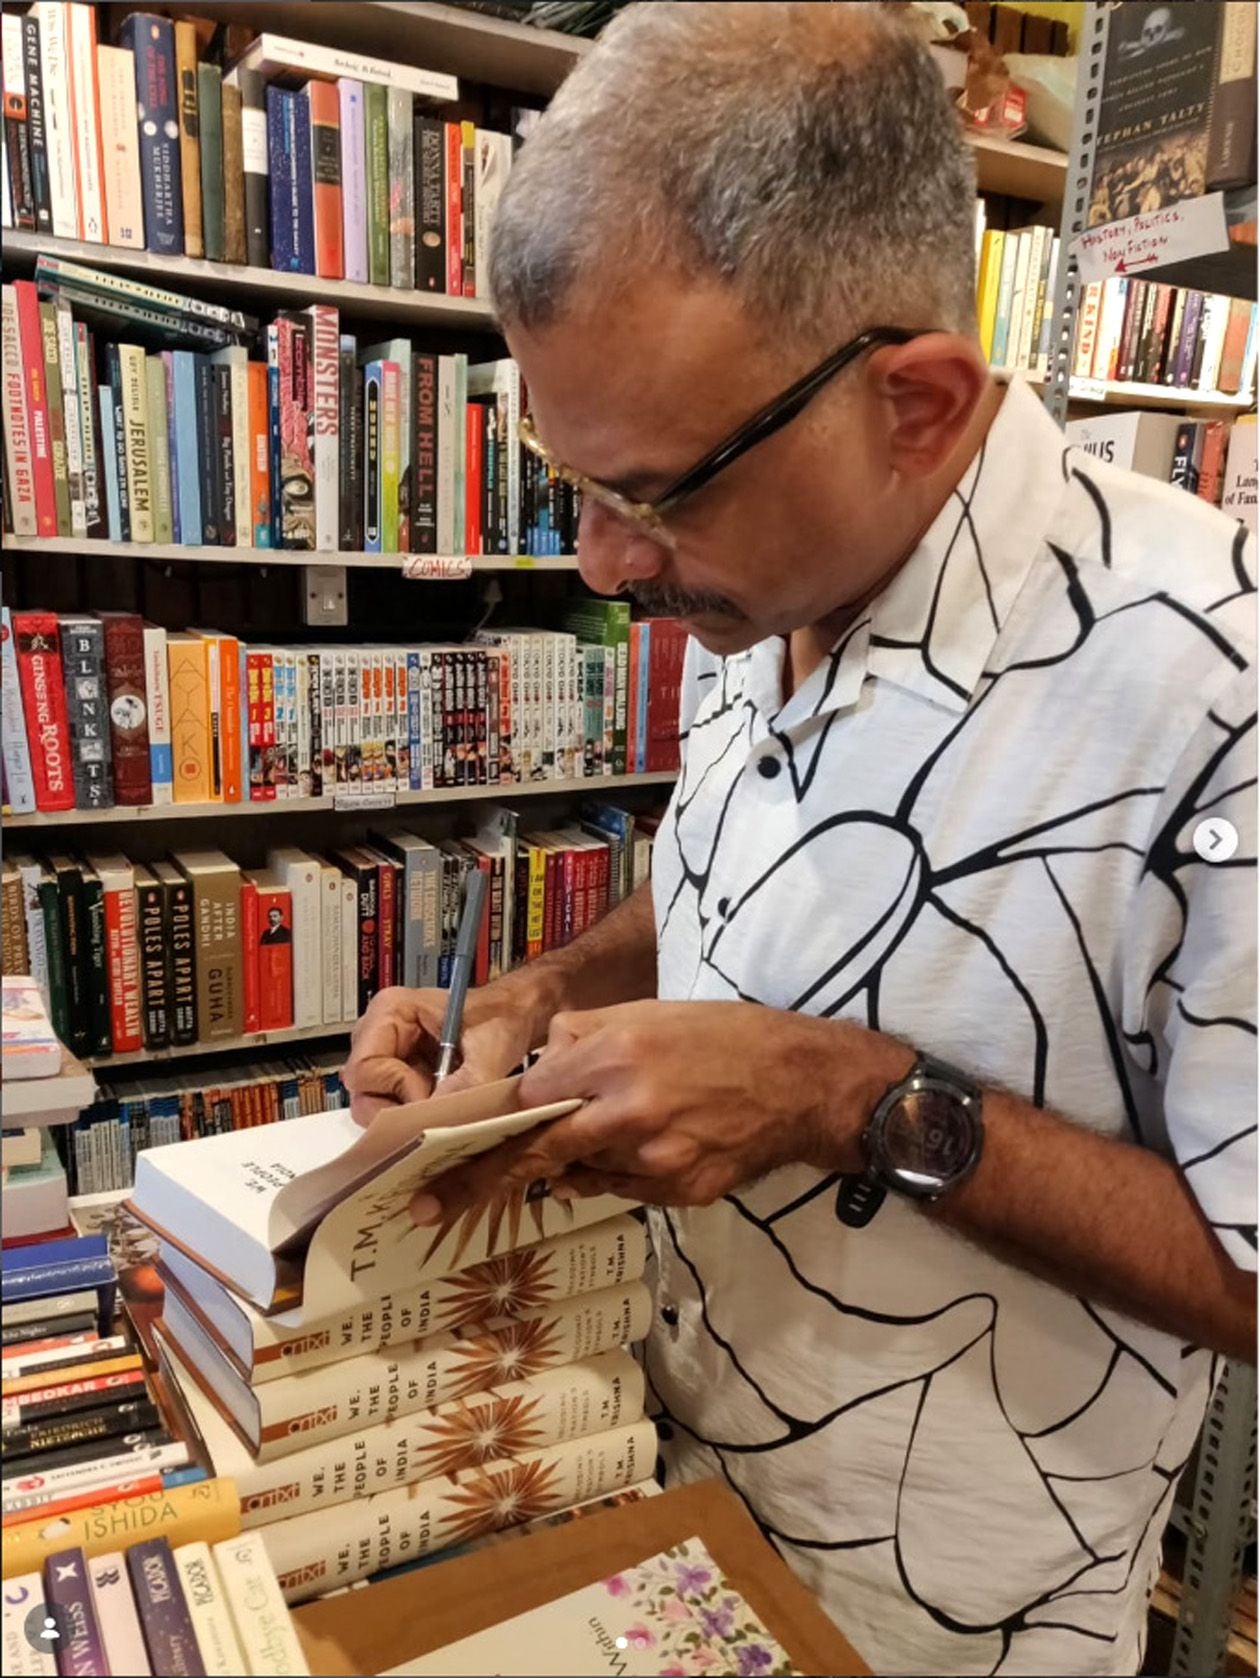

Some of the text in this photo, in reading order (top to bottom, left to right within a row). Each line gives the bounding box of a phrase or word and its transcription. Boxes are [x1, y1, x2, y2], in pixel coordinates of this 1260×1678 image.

[26, 23, 44, 148] GENE MACHINE
[1096, 102, 1206, 146] TEPHAN TALTY
[430, 130, 441, 180] DONNA
[152, 145, 164, 220] MUKHERJEE
[161, 142, 174, 226] SIDDHARTHA
[315, 305, 339, 436] MONSTERS
[418, 358, 434, 426] FROM
[7, 373, 26, 446] FOOTNOTES
[33, 410, 47, 458] PALESTINE
[15, 450, 27, 463] IN
[130, 419, 150, 512] JERUSALEM
[418, 432, 434, 498] HELL
[16, 468, 32, 502] GAZA
[407, 557, 467, 579] COMICS
[31, 655, 64, 792] GINSENG ROOTS
[153, 693, 164, 734] TSUGE
[200, 898, 211, 948] GANDHI
[212, 901, 224, 941] AFTER
[225, 902, 236, 939] INDIA
[360, 893, 370, 917] DUTT
[382, 872, 393, 948] GIRLS STRAY
[8, 885, 24, 975] BIRDS OF PREY
[173, 905, 193, 1003] POLES APART
[118, 891, 140, 1037] REVOLUTIONARY WEALTH
[144, 907, 165, 1005] POLES APART
[207, 968, 224, 1024] GUHA
[360, 1310, 375, 1342] THE
[400, 1306, 412, 1328] OF
[416, 1289, 431, 1334] INDIA
[368, 1383, 380, 1417] THE
[385, 1362, 400, 1424] PEOPLE
[408, 1379, 419, 1400] OF
[424, 1360, 438, 1405] INDIA
[333, 1460, 347, 1494] THE
[353, 1439, 366, 1499] PEOPLE
[375, 1456, 388, 1477] OF
[394, 1437, 409, 1482] INDIA
[83, 1502, 178, 1541] ISHIDA
[400, 1529, 411, 1552] OF
[358, 1537, 371, 1571] THE
[68, 1600, 92, 1660] WEISS
[588, 1615, 630, 1677] Within
